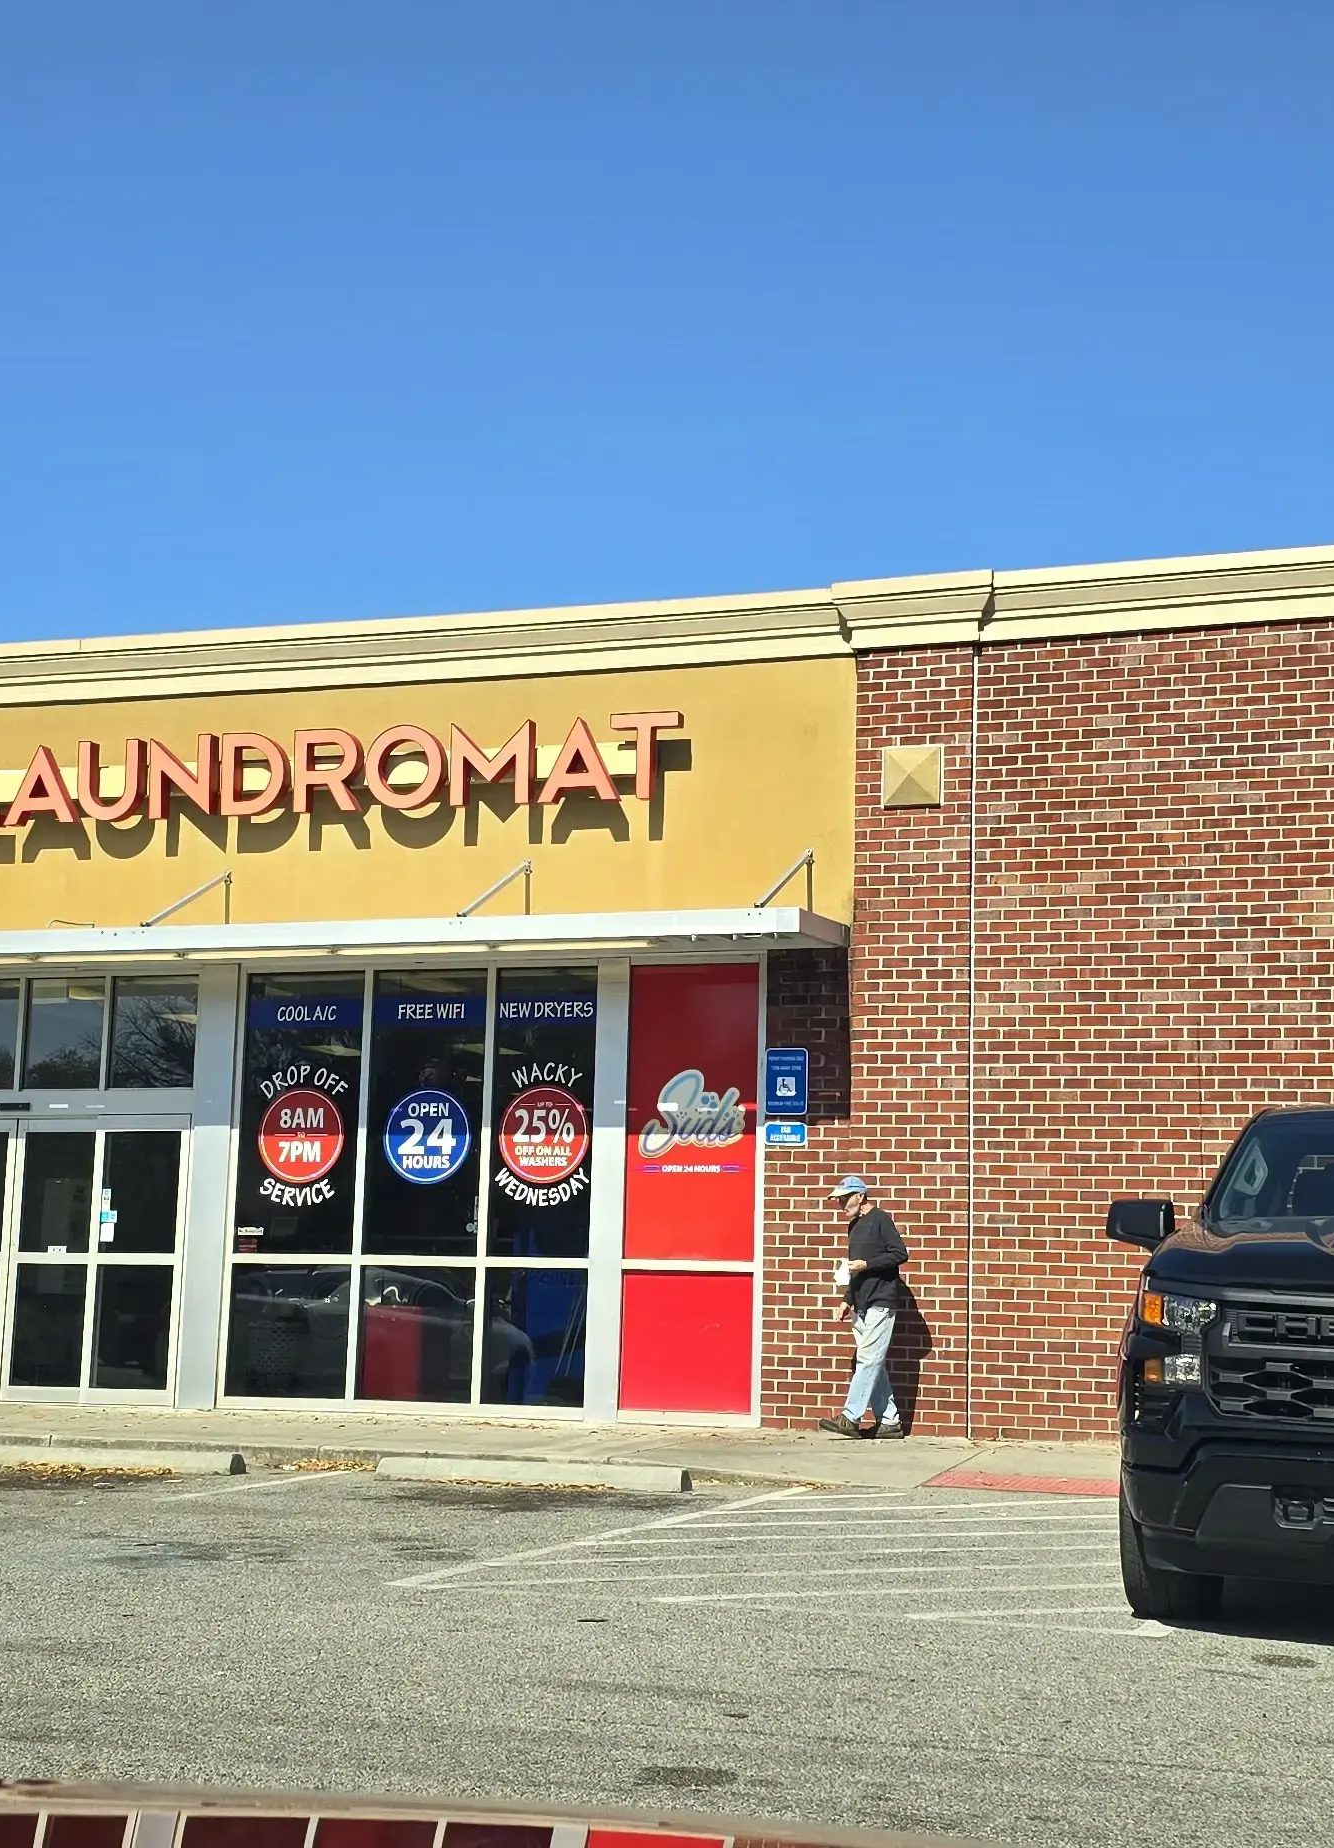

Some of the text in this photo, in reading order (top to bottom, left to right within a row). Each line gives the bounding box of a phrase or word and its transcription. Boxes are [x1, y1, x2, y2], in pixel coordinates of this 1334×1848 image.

[277, 1005, 337, 1022] COOL A/C
[397, 1002, 465, 1020] FREE WIFI
[499, 1001, 594, 1019] NEW DRYERS
[259, 1065, 349, 1099] DROP OFF
[511, 1062, 583, 1088] WACKY
[279, 1107, 324, 1129] 8AM
[407, 1102, 450, 1117] OPEN
[641, 1070, 743, 1156] Suds
[397, 1118, 457, 1155] 24
[512, 1108, 575, 1144] 25%
[278, 1140, 321, 1163] 7PM
[514, 1145, 573, 1156] OFF ON ALL
[519, 1156, 568, 1167] WASHERS
[402, 1155, 451, 1169] HOURS
[259, 1178, 335, 1207] SERVICE
[494, 1167, 590, 1207] WEDNESDAY
